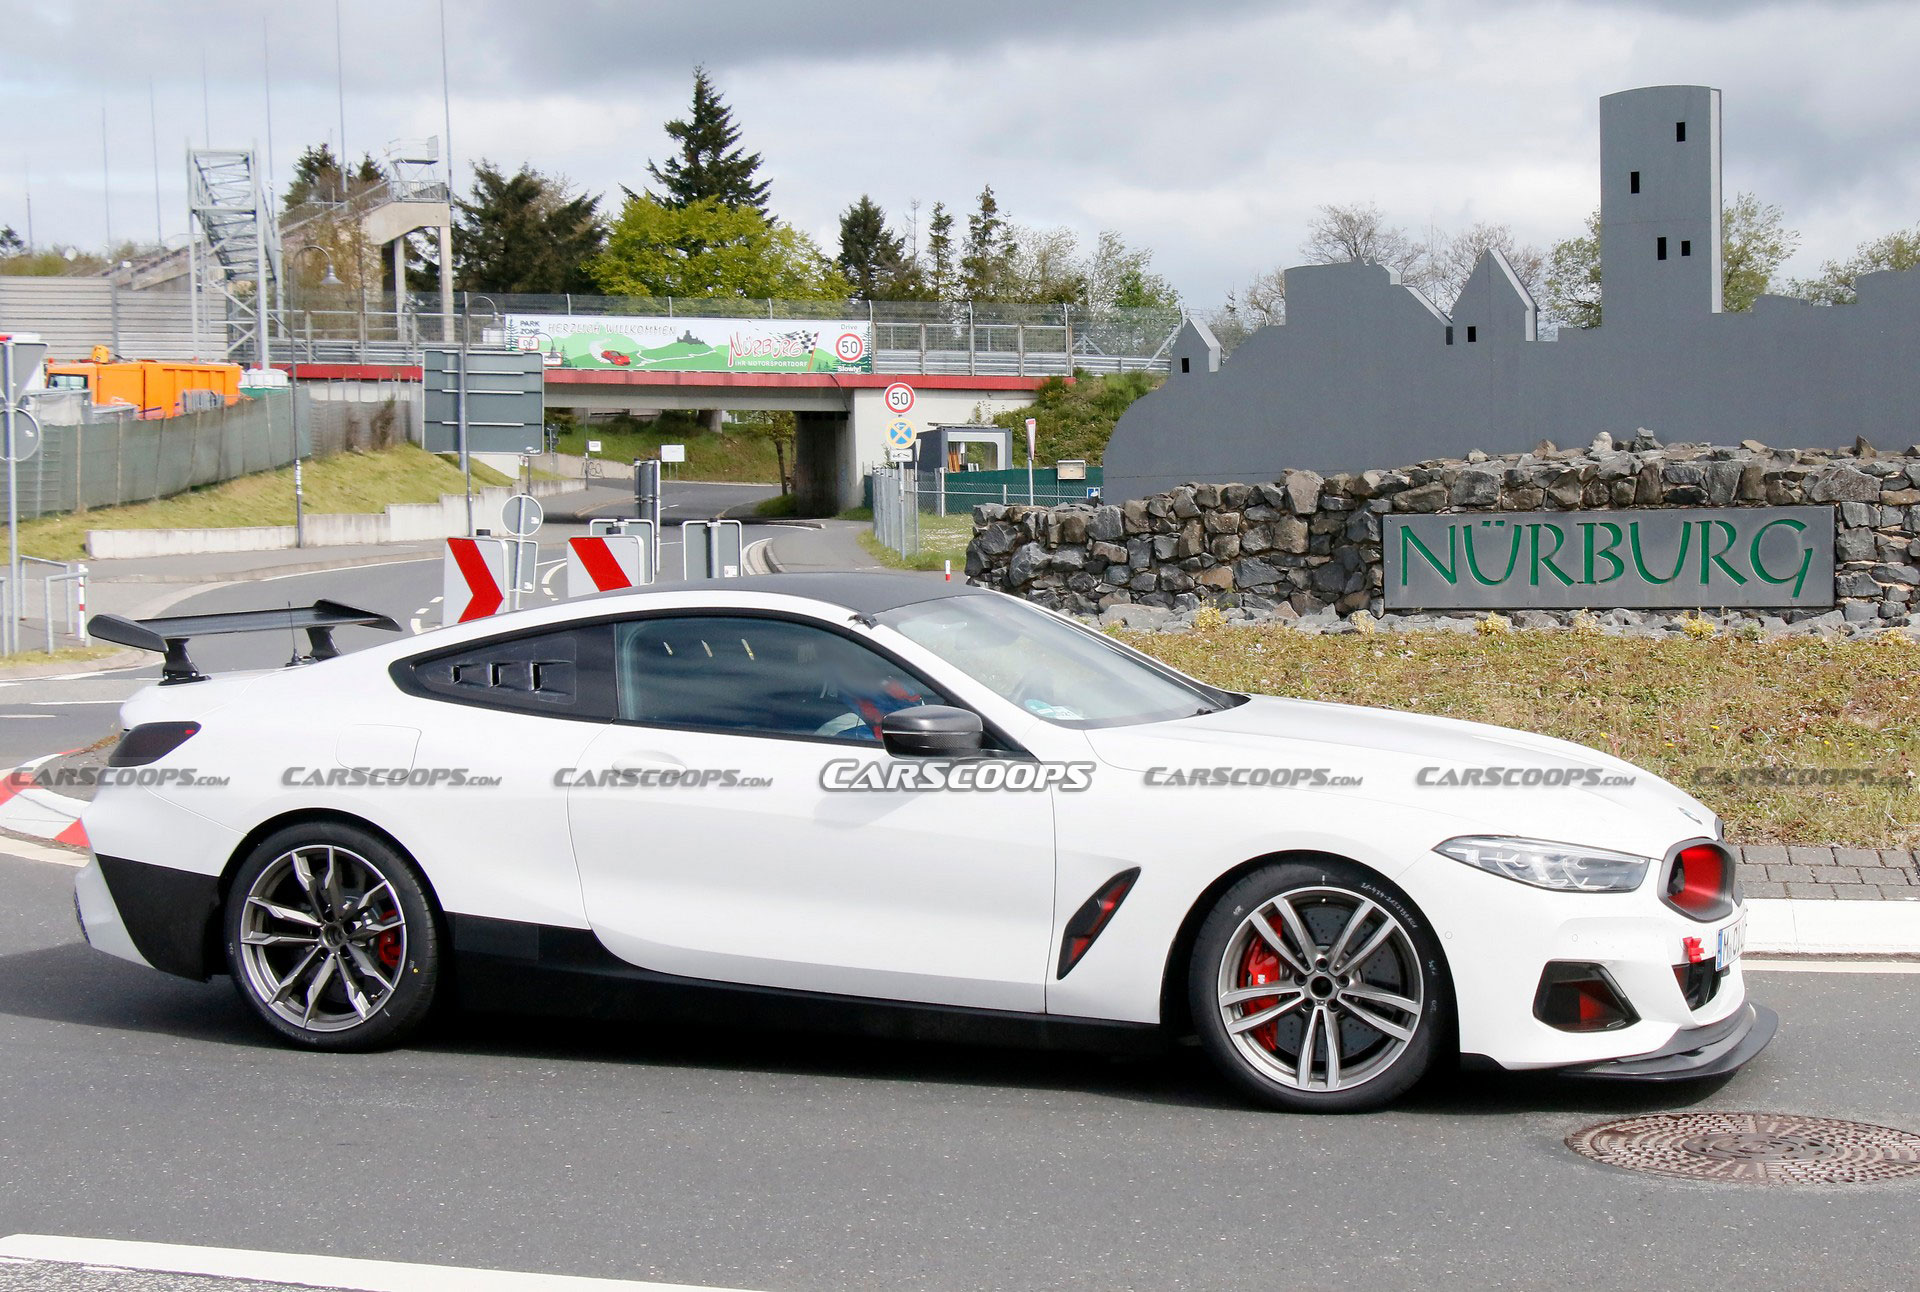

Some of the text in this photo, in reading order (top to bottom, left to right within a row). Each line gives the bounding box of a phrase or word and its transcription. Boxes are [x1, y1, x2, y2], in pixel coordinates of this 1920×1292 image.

[548, 323, 677, 335] HERZLICH WILLKOMMEN
[841, 340, 858, 354] 50
[891, 391, 909, 406] 50
[1399, 517, 1815, 599] NÜRBURG
